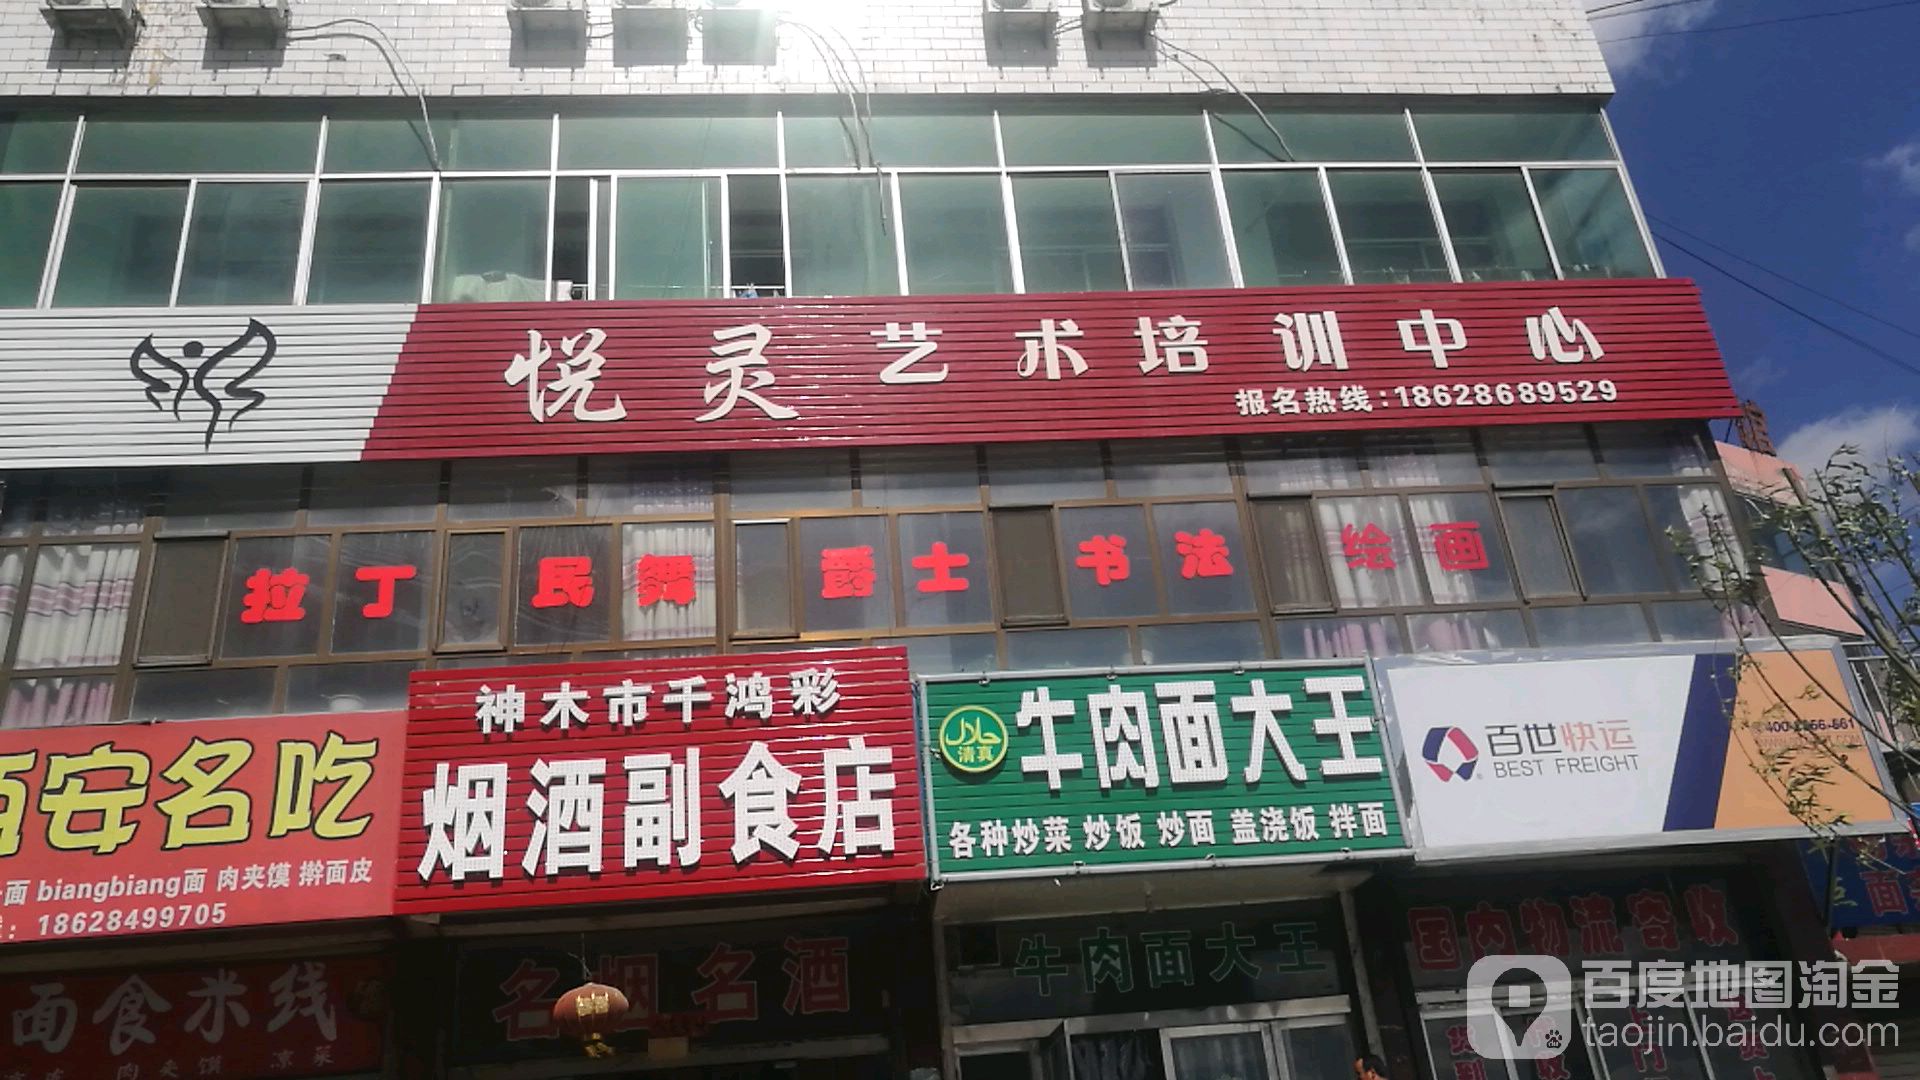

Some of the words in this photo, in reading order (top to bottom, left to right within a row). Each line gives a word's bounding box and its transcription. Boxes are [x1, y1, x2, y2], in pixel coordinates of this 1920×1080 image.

[475, 667, 841, 734] 神木市千鸿彩
[957, 745, 994, 763] 清真
[1015, 676, 1383, 790] 牛肉面大王
[1485, 719, 1637, 757] 百世快运
[1493, 759, 1544, 778] BEST
[1555, 754, 1639, 775] FREIGHT
[417, 736, 897, 881] 烟酒副食店
[949, 816, 1072, 859] 各种炒菜
[1083, 813, 1145, 851] 炒饭
[1156, 809, 1216, 847] 炒面
[1230, 805, 1320, 844] 盖浇饭
[1329, 802, 1388, 838] 拌面
[37, 868, 208, 903] biangbiang面
[216, 862, 291, 892] 肉夹馍
[38, 902, 227, 936] 18628499705
[1012, 921, 1328, 997] 牛肉面大王
